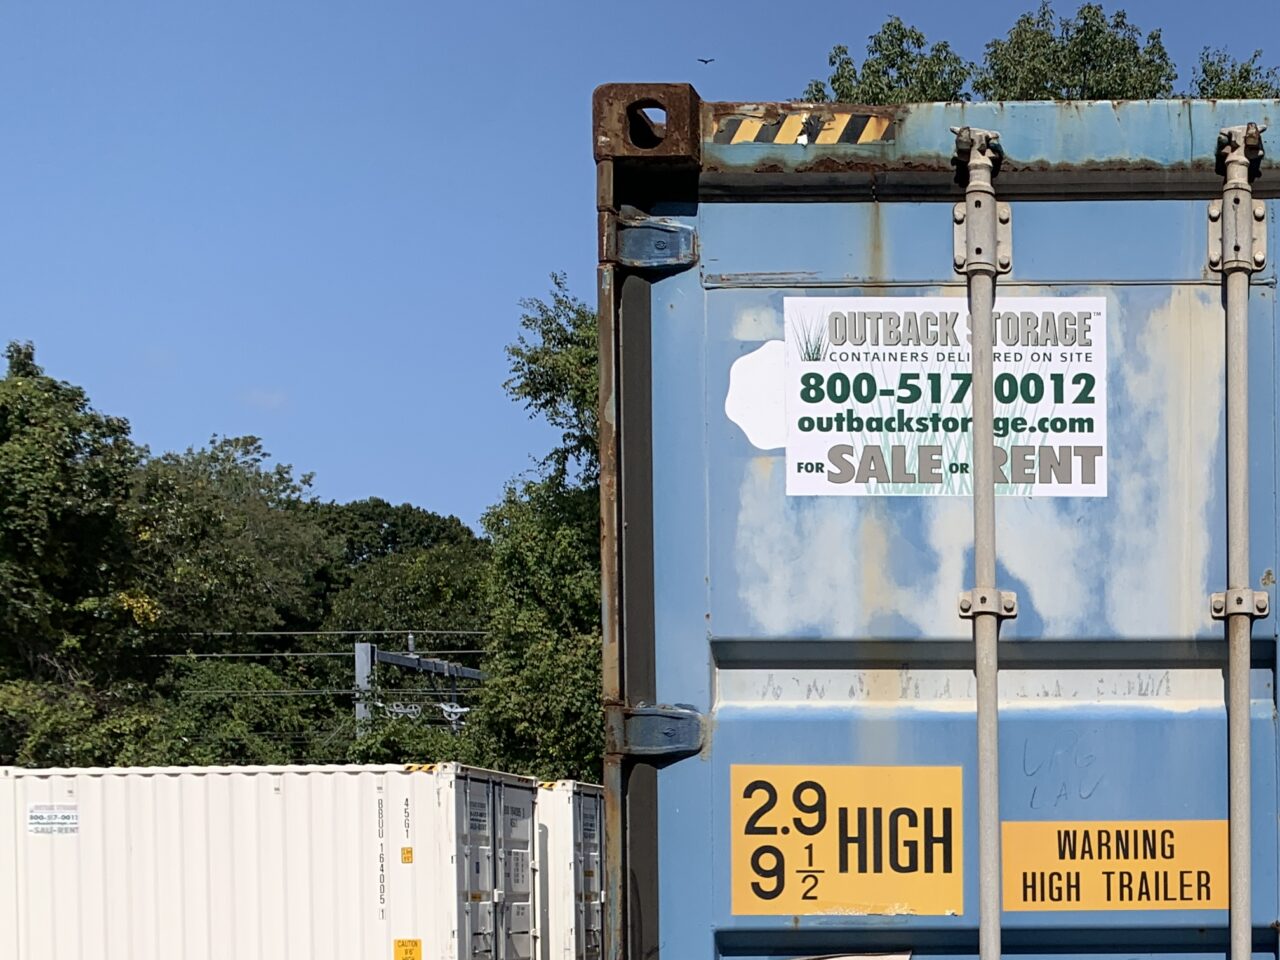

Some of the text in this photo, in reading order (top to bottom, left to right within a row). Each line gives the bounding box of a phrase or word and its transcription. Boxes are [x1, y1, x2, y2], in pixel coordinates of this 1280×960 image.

[828, 311, 960, 346] OUTBACK
[829, 352, 1093, 362] CONTAINERS DELIRED ON SITE
[800, 372, 1096, 404] 800-5170012
[798, 409, 1094, 438] outbackstorge.com
[797, 462, 825, 473] FOR
[827, 444, 943, 484] SALE
[949, 463, 969, 474] OR
[743, 780, 952, 873] 2.9 HIGH
[1057, 829, 1175, 860] WARNING
[1022, 871, 1211, 902] HIGH TRAILER
